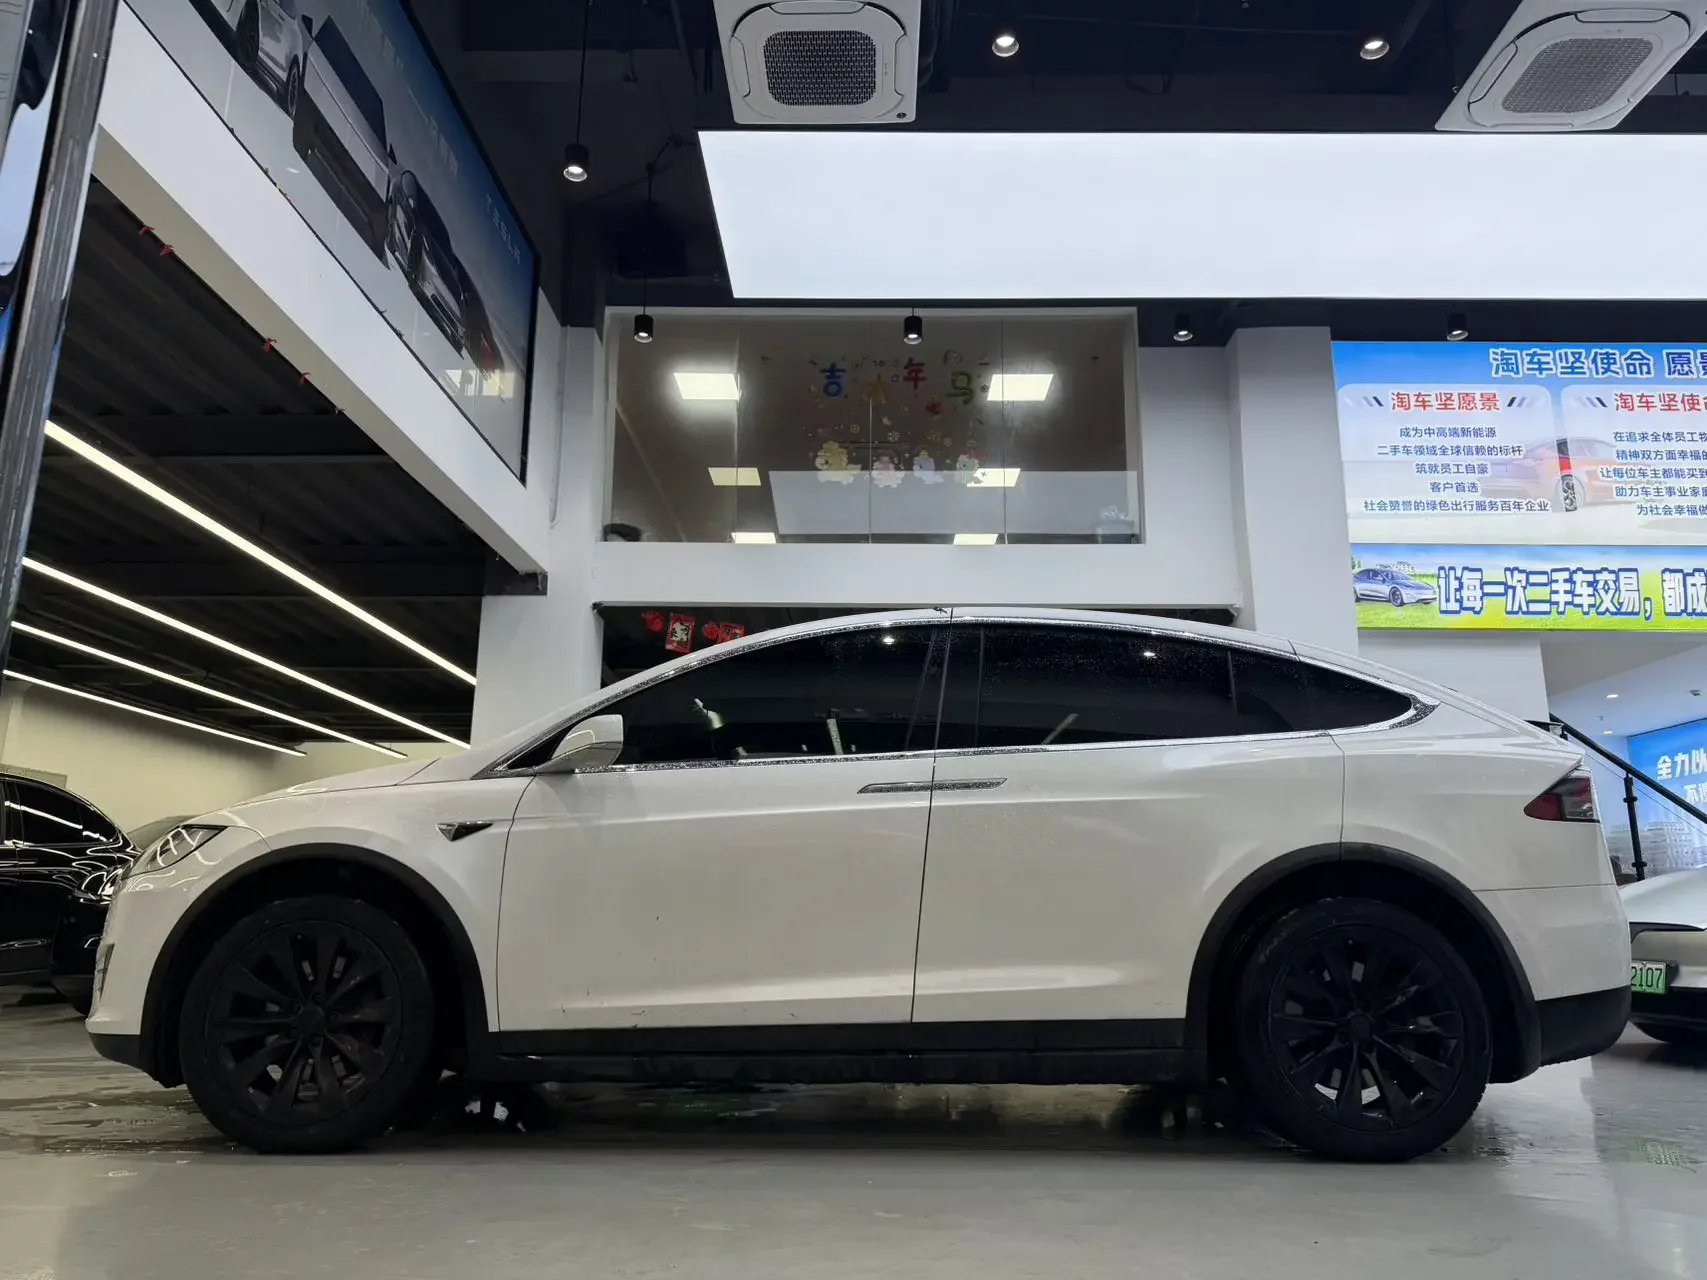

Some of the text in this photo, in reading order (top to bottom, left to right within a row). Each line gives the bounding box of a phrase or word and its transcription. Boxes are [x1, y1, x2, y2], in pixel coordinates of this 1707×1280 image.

[1489, 348, 1654, 377] 淘车坚使命
[1391, 392, 1501, 411] 淘车坚愿景
[1614, 392, 1707, 412] 淘车坚使
[1399, 426, 1497, 438] 成为中高端新能源
[1377, 444, 1524, 457] 二手车领域全球信赖的标杆
[1415, 463, 1489, 475] 筑就员工自豪
[1599, 467, 1707, 479] 让每位车主都能买到
[1429, 481, 1480, 493] 客户首选
[1364, 499, 1550, 512] 社会赞誉的绿色出行服务百年企业
[1630, 966, 1663, 988] 2107
